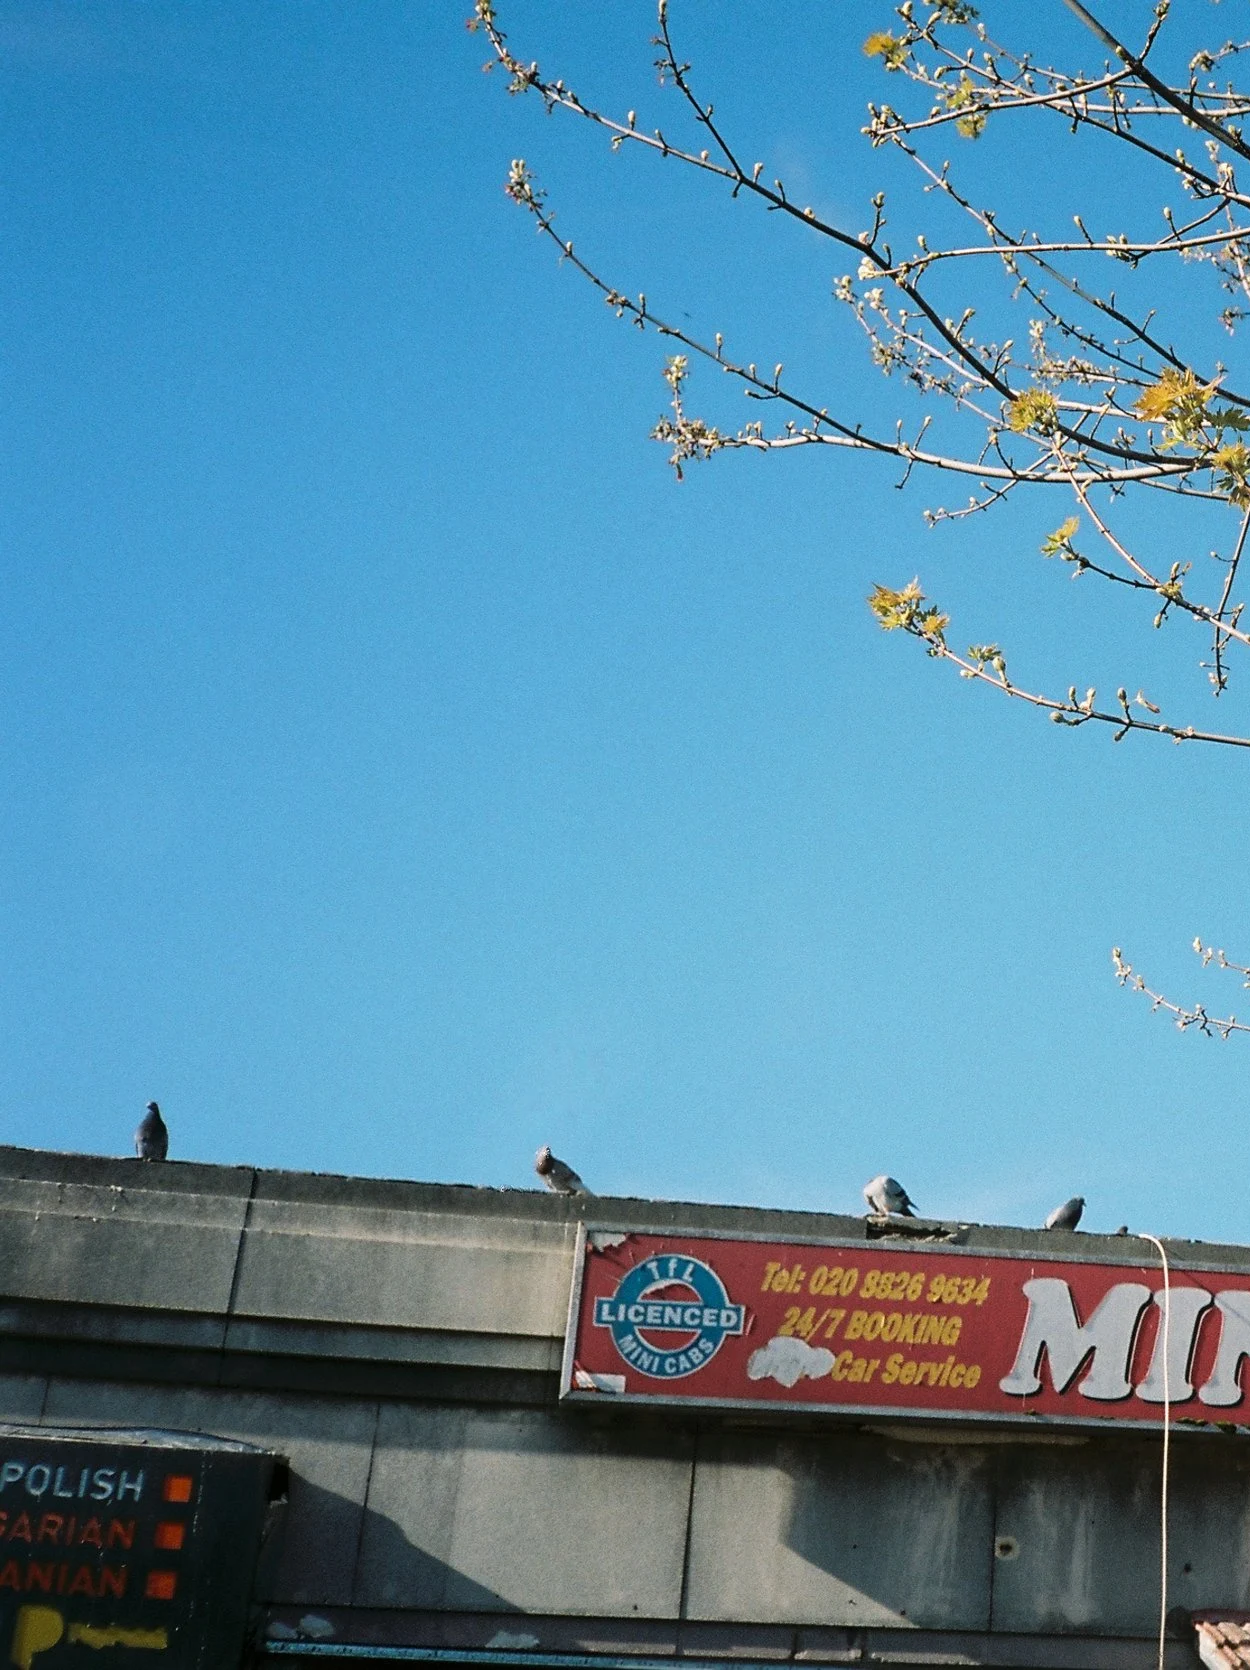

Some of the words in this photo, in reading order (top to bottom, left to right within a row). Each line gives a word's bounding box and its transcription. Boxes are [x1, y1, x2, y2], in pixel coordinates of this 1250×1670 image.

[647, 1258, 695, 1282] TfL
[761, 1262, 806, 1293] Tel:
[809, 1265, 858, 1297] 020
[859, 1269, 925, 1301] 8826
[926, 1274, 991, 1306] 9634
[601, 1303, 738, 1328] LICENCED
[778, 1306, 847, 1342] 24/7
[844, 1310, 962, 1346] BOOKING
[619, 1334, 660, 1373] MINI
[664, 1338, 714, 1374] CABS
[831, 1351, 880, 1383] Car
[881, 1353, 982, 1388] Service
[0, 1462, 146, 1502] POLISH
